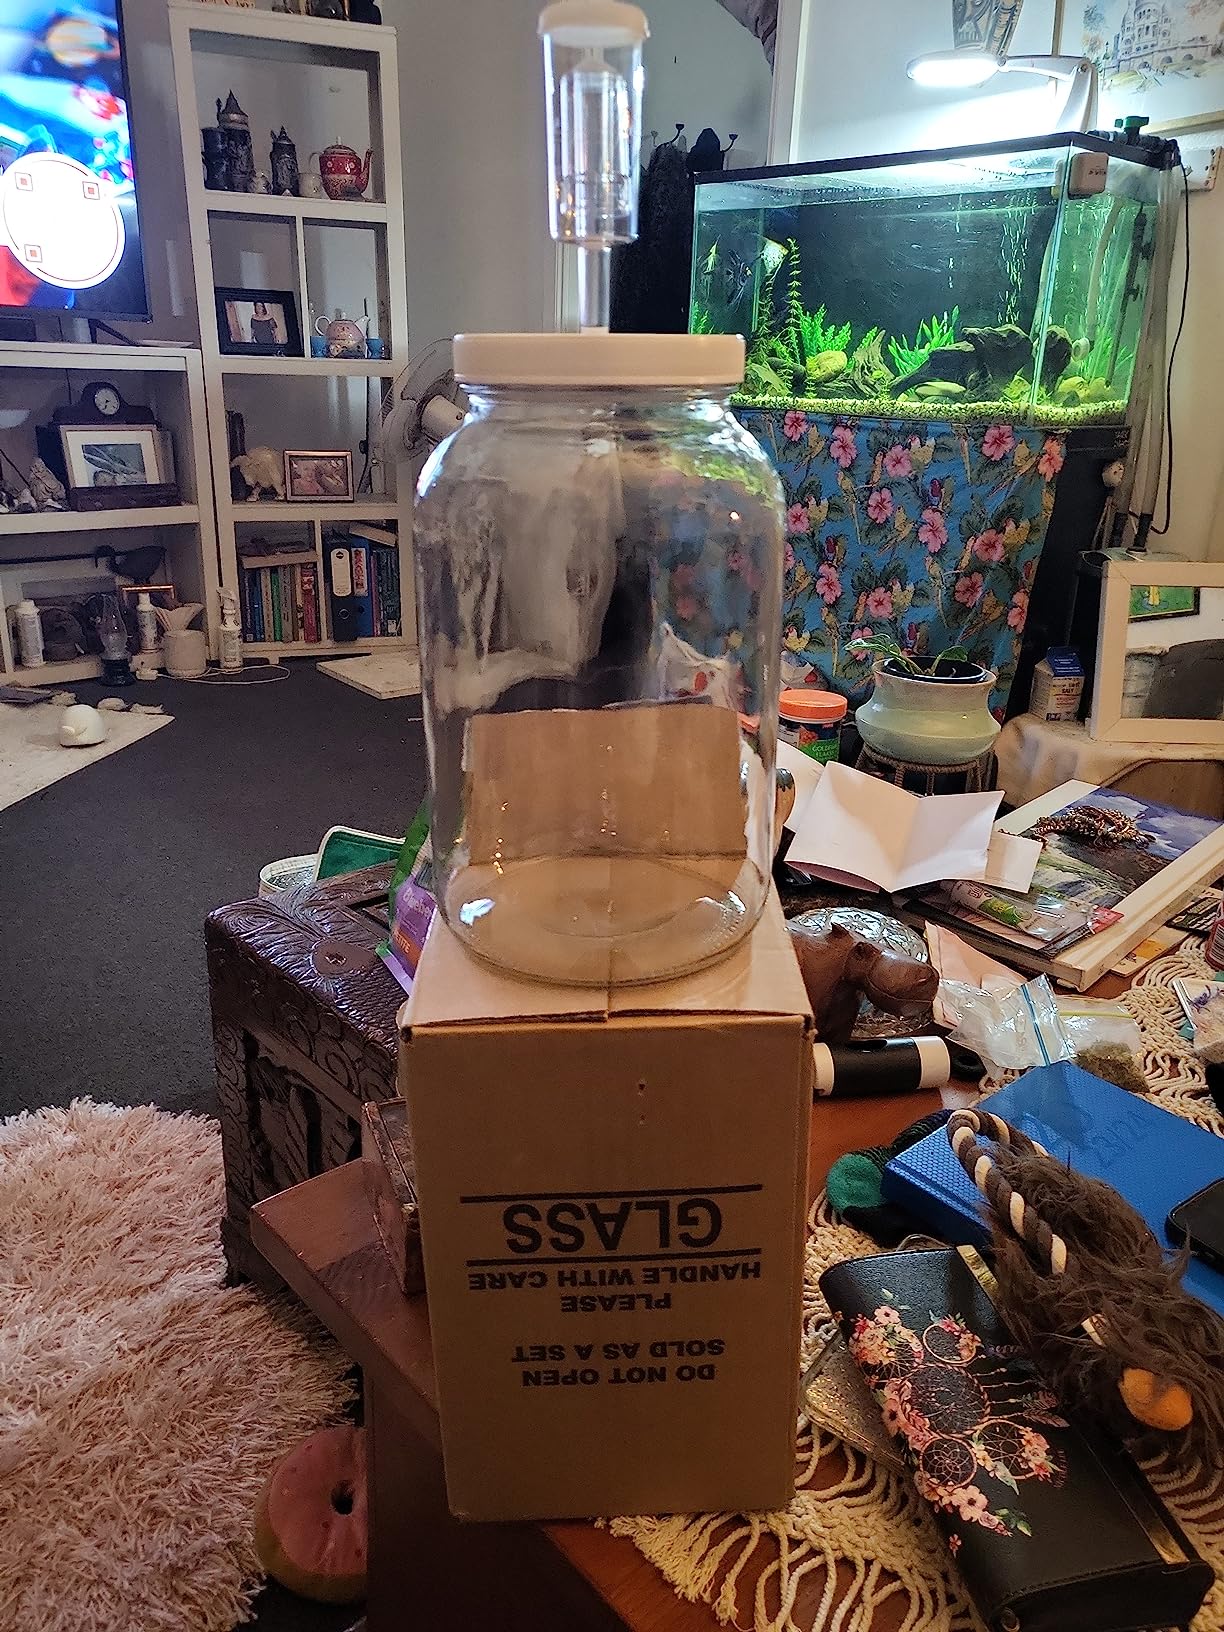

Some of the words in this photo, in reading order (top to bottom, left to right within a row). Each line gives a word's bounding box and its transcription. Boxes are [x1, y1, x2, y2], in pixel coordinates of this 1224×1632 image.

[502, 1197, 722, 1254] GLASS
[468, 1270, 548, 1290] CARE
[557, 1267, 634, 1287] WITH
[643, 1261, 761, 1285] HANDLE
[560, 1292, 673, 1313] PLEASE
[511, 1345, 566, 1363] SET
[573, 1344, 594, 1361] A
[602, 1342, 641, 1361] AS
[650, 1338, 726, 1359] SOLD
[522, 1368, 600, 1388] OPEN
[607, 1366, 667, 1384] NOT
[675, 1364, 716, 1382] DO
